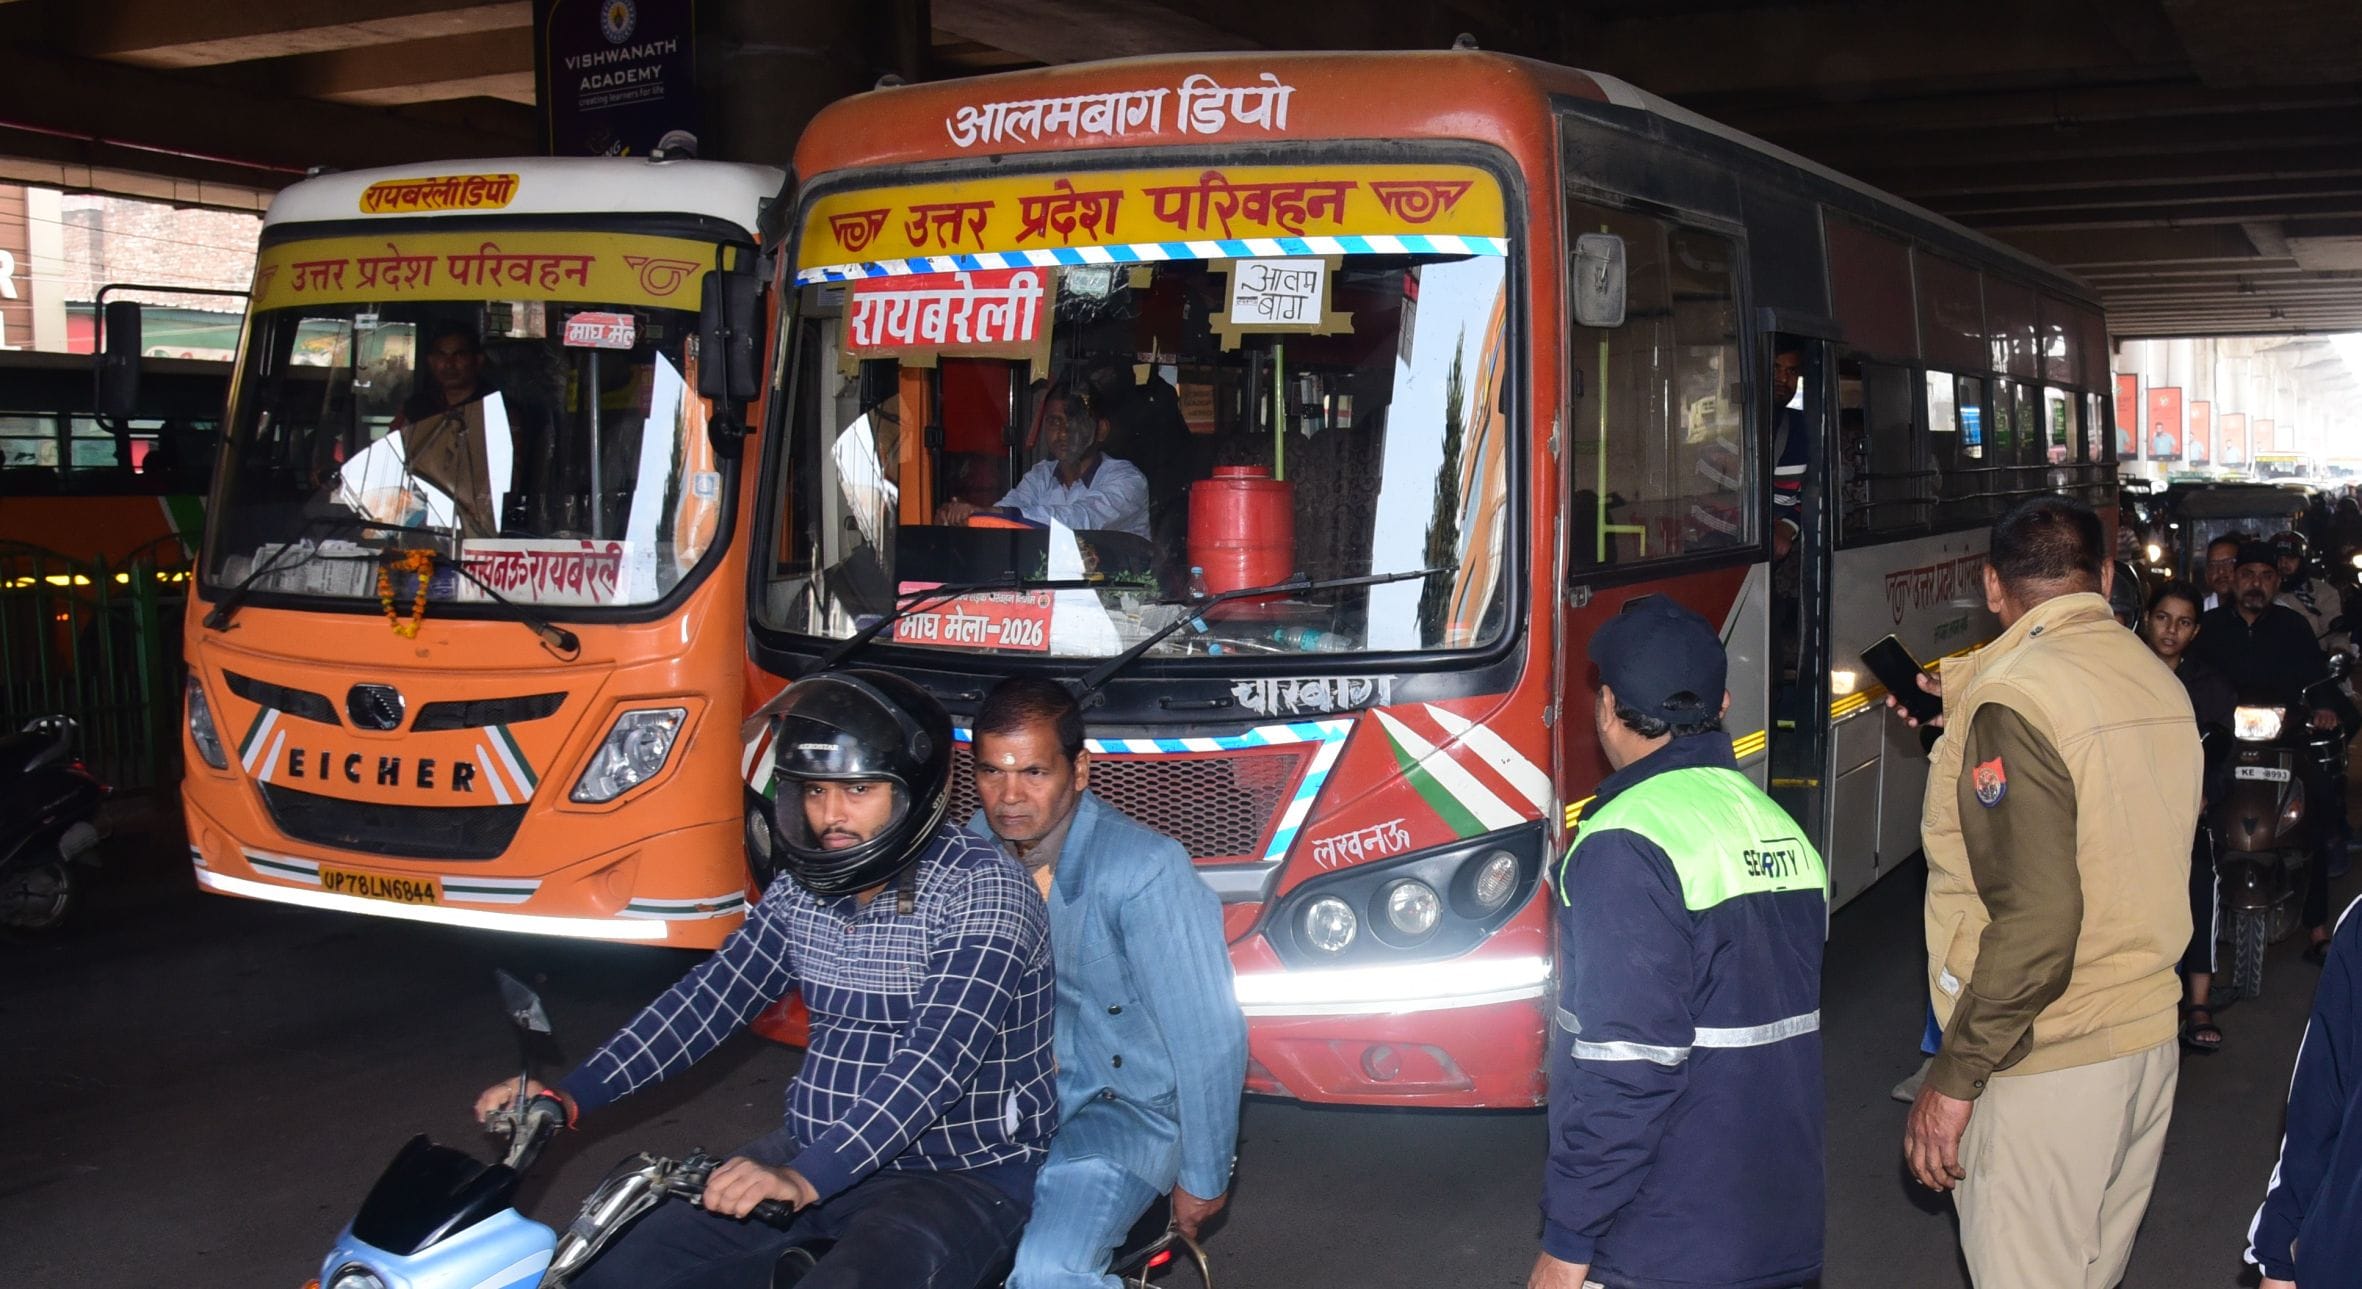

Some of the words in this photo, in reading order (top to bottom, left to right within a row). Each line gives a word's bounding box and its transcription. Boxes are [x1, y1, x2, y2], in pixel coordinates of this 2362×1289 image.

[565, 40, 677, 69] VISHWANATH
[580, 65, 662, 91] ACADEMY
[946, 87, 1171, 148] आलमबाग
[1177, 73, 1297, 134] डिपो
[366, 176, 460, 212] रायबरेली
[904, 200, 994, 250] उत्तर
[1015, 178, 1124, 244] प्रदेश
[1141, 170, 1358, 239] परिवहन
[291, 259, 349, 291] उत्तर
[357, 243, 438, 291] प्रदेश
[447, 241, 596, 291] परिवहन
[852, 271, 1044, 346] रायबरेली
[900, 612, 941, 640] माघ
[289, 748, 476, 792] EICHER
[1312, 818, 1410, 870] लखनऊ
[324, 871, 436, 903] UP78LN6844
